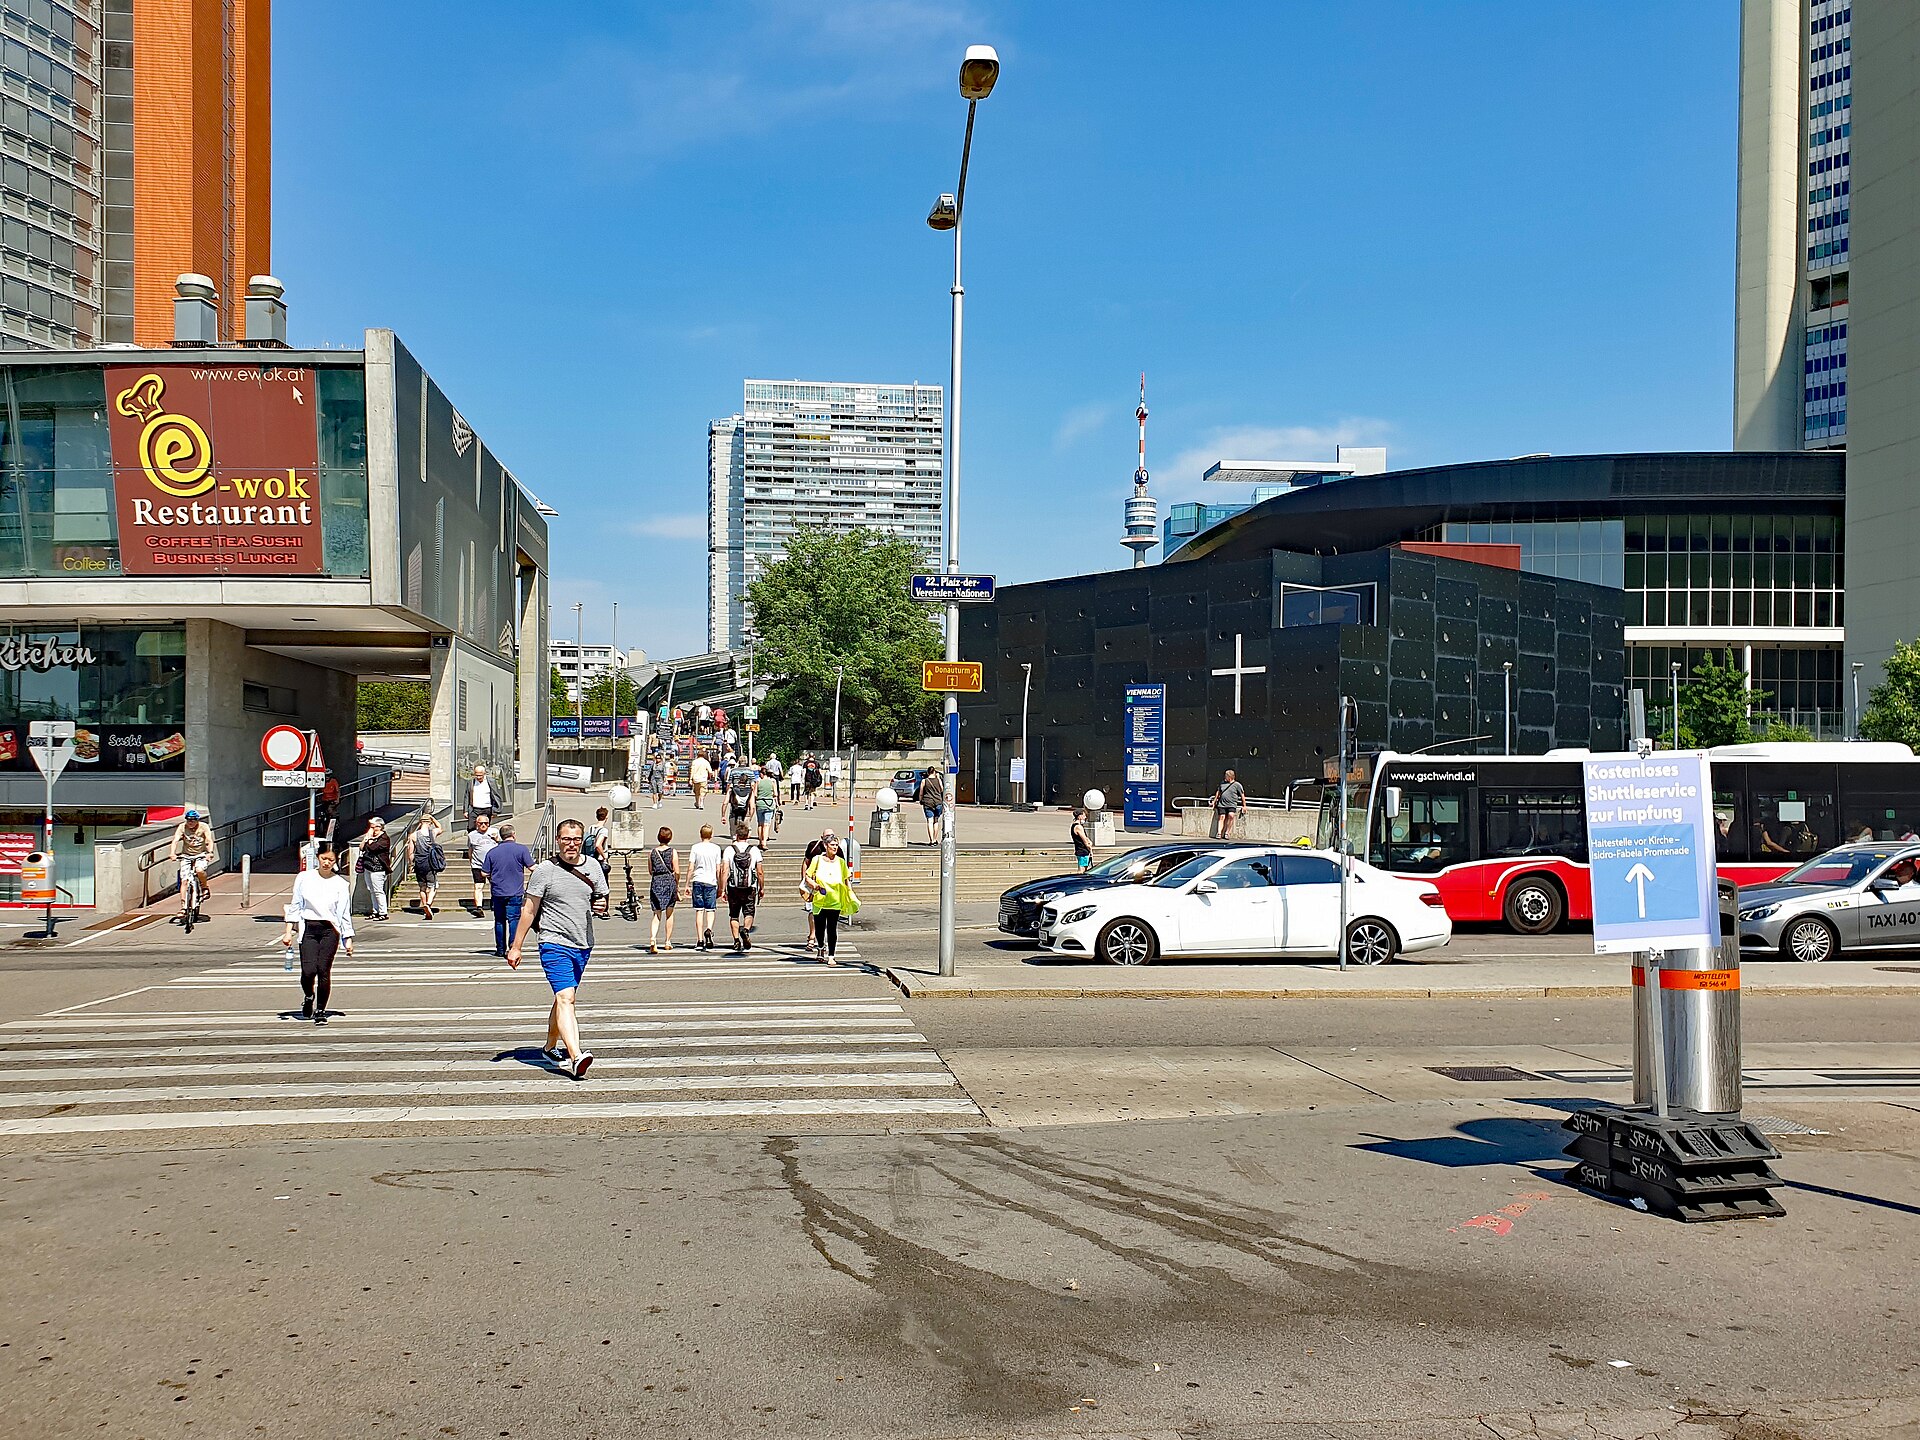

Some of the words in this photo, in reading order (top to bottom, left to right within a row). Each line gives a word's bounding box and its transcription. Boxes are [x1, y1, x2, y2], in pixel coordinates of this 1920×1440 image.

[190, 367, 305, 382] www.ewok.at
[131, 498, 312, 525] Restaurant
[63, 556, 106, 571] Coffee
[940, 577, 980, 587] Platz-der-
[915, 587, 990, 598] Vereinten-Nationen
[934, 665, 971, 674] Donauturm
[108, 734, 142, 747] Sushi
[1390, 770, 1475, 783] www.gschwindl.at
[1587, 762, 1680, 780] Kostenloses
[1588, 782, 1697, 802] Shuttleservice
[1589, 810, 1615, 823] zur
[1617, 804, 1683, 825] Impfung
[1591, 837, 1633, 848] Haltestelle
[1634, 837, 1647, 846] vor
[1648, 835, 1674, 845] Kirche
[1591, 847, 1643, 860] Isidro-Fabela
[1643, 845, 1691, 857] Promenade
[1867, 913, 1897, 928] TAXI
